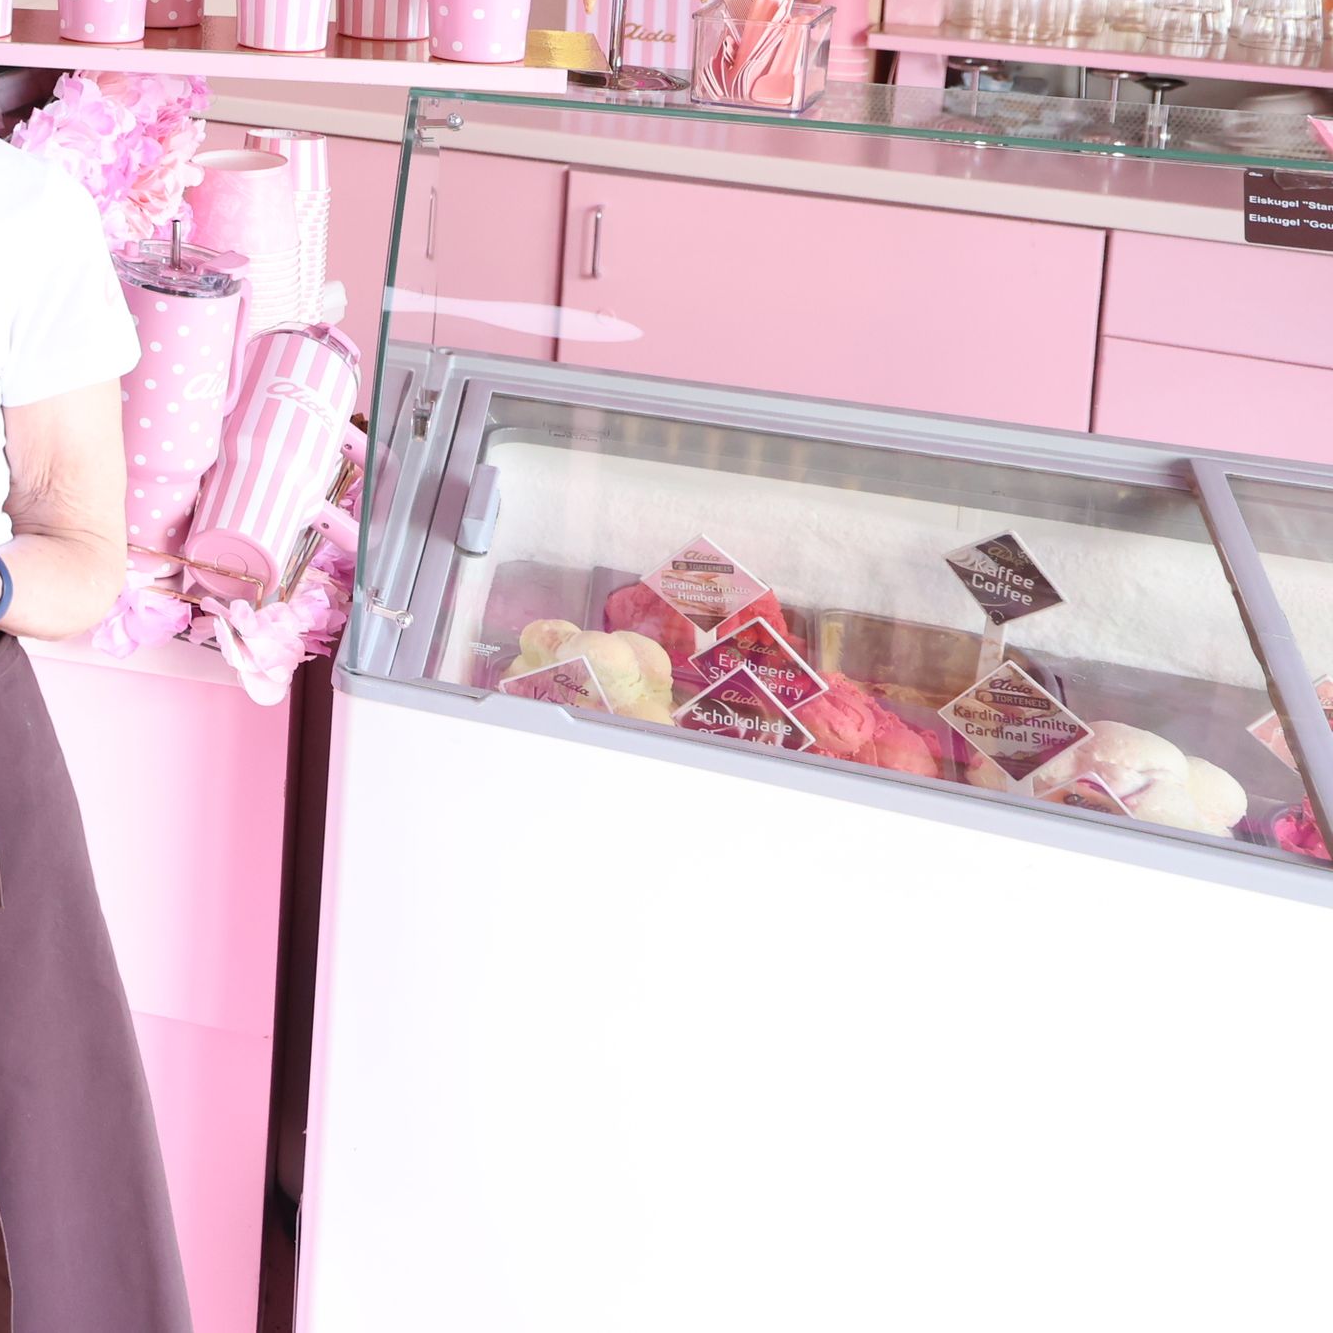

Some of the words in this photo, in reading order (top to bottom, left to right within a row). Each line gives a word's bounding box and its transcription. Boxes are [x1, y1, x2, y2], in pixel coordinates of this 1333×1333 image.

[1249, 196, 1299, 208] Eiskugel
[1249, 213, 1300, 226] Eiskugel
[974, 559, 1035, 590] Kaffee
[972, 573, 1033, 606] Coffee
[692, 706, 793, 736] Schokolade
[953, 705, 1078, 733] Kardinalschnitte
[965, 723, 1028, 743] Cardinal
